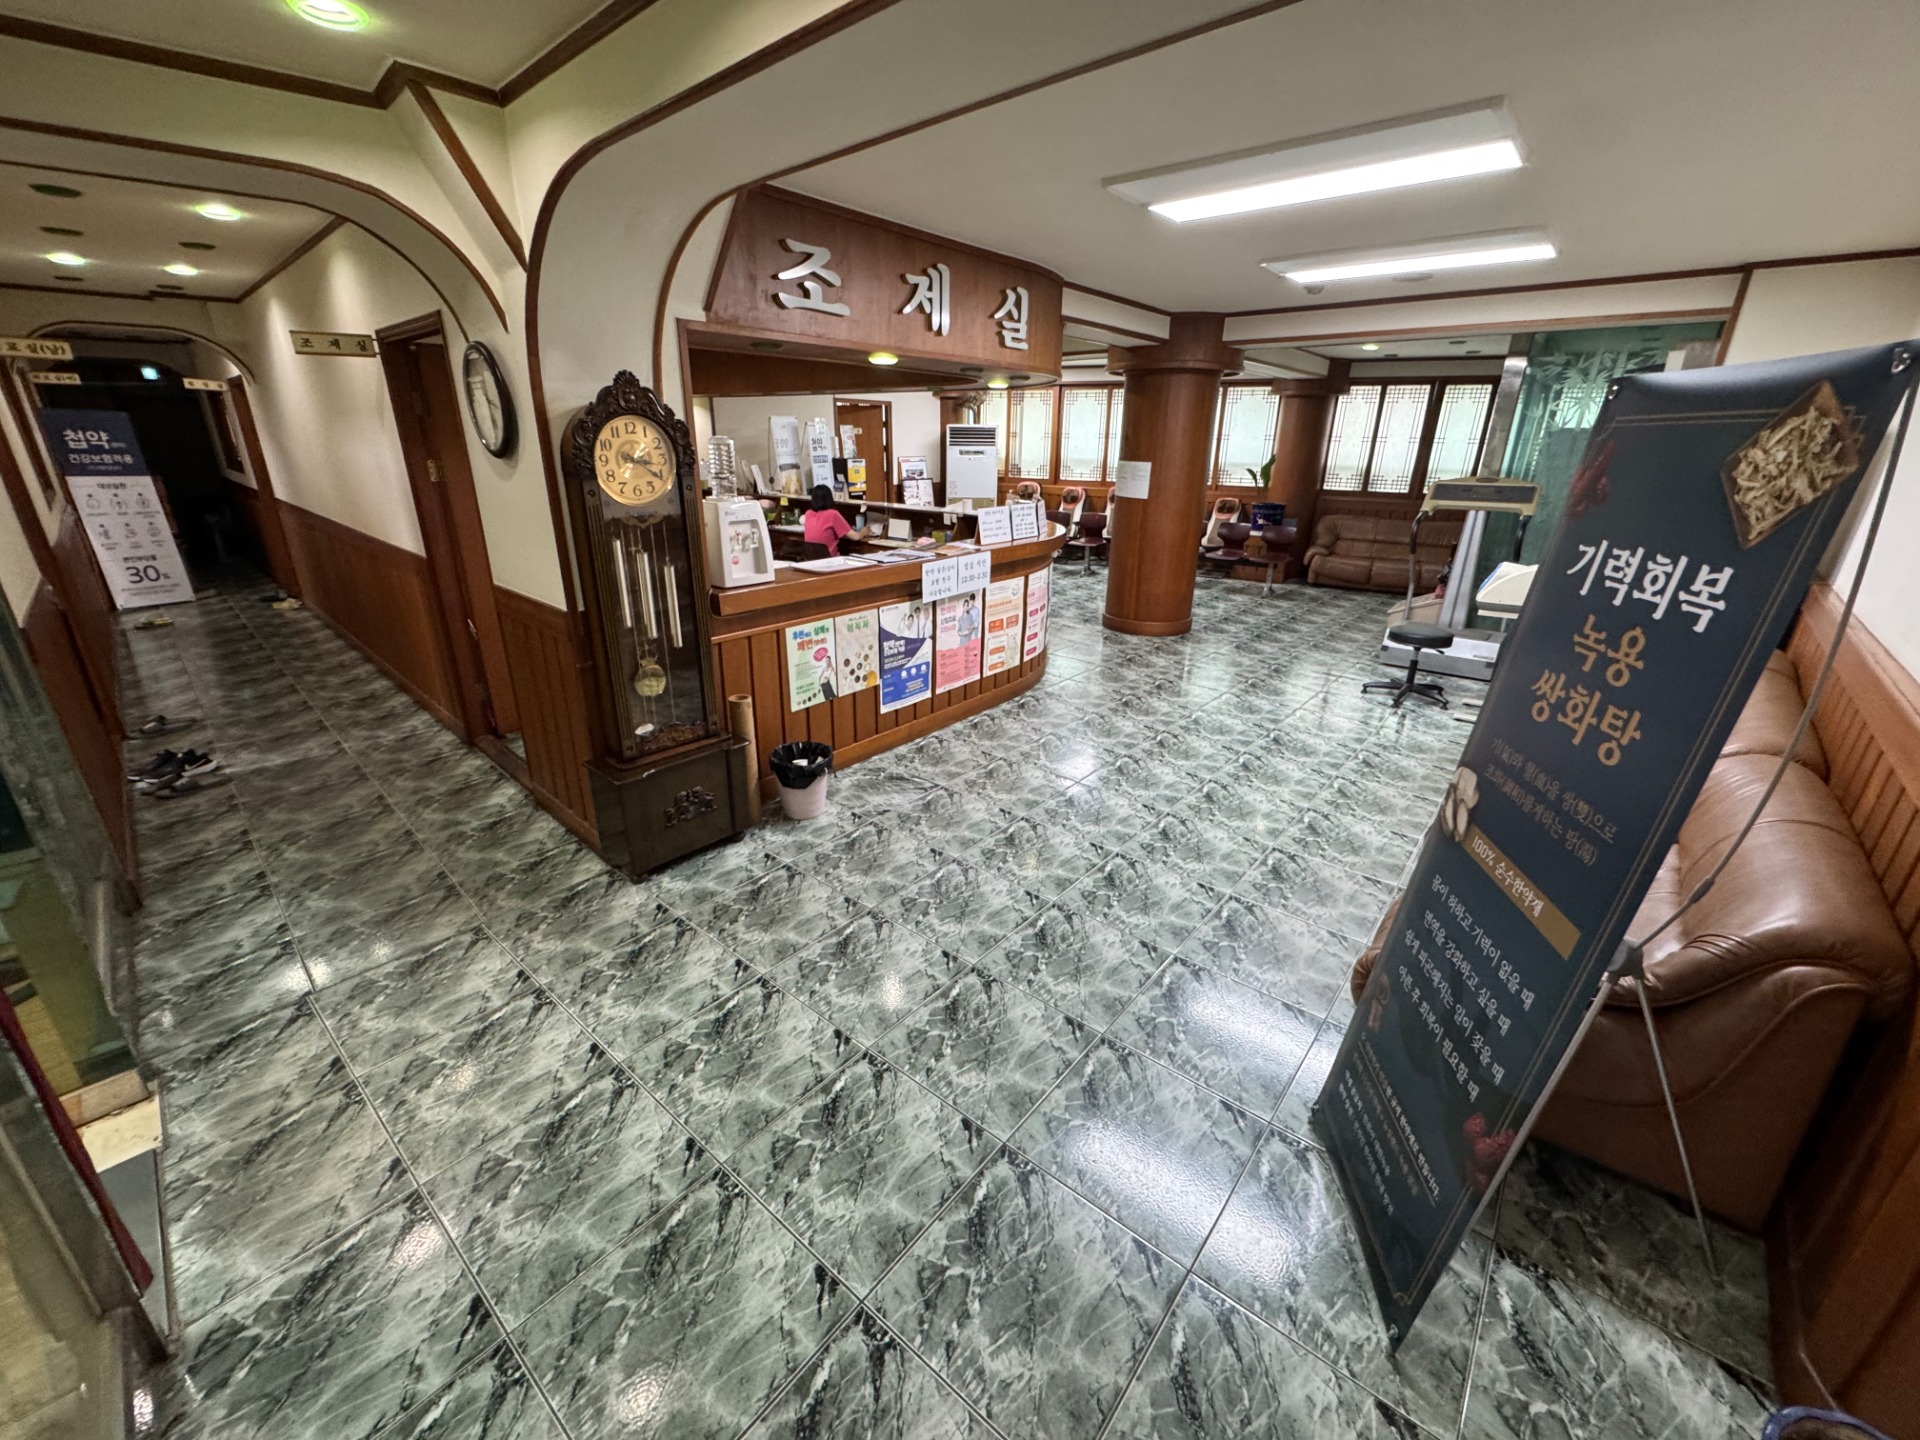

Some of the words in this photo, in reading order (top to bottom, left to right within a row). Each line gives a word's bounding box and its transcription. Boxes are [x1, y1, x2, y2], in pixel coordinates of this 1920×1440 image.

[778, 238, 1029, 350] 조제실
[300, 337, 368, 352] 조제실
[610, 426, 620, 438] 11
[624, 421, 637, 434] 12
[643, 426, 647, 438] 1
[62, 429, 110, 449] 첩약
[600, 438, 612, 452] 10
[652, 437, 661, 450] 2
[598, 454, 609, 467] 9
[658, 453, 667, 466] 3
[605, 469, 616, 483] 8
[618, 482, 627, 494] 7
[633, 484, 642, 497] 6
[646, 481, 655, 494] 5
[1566, 539, 1734, 633] 기력회복
[1573, 614, 1646, 688] 녹용
[1530, 669, 1643, 766] 쌍화탕
[1472, 836, 1496, 867] 100%
[1496, 861, 1545, 919] 순수한약재
[1432, 874, 1449, 901] 몸이
[1448, 894, 1473, 931] 허하고
[1472, 925, 1500, 967] 기력이
[1498, 960, 1521, 995] 없을
[1520, 989, 1535, 1012] 때
[1423, 909, 1446, 947] 면역을
[1445, 940, 1479, 992] 강화하고
[1478, 987, 1500, 1020] 싶을
[1497, 1014, 1512, 1037] 때
[1404, 928, 1421, 956] 쉽게
[1418, 949, 1455, 1010] 피곤해지는
[1454, 1004, 1474, 1037] 일이
[1470, 1031, 1494, 1066] 잦을
[1491, 1063, 1506, 1087] 때
[1398, 965, 1412, 991] 아픈
[1410, 988, 1421, 1004] 후
[1419, 1000, 1444, 1043] 회복이
[1442, 1039, 1470, 1087] 필요할
[1467, 1079, 1480, 1103] 때
